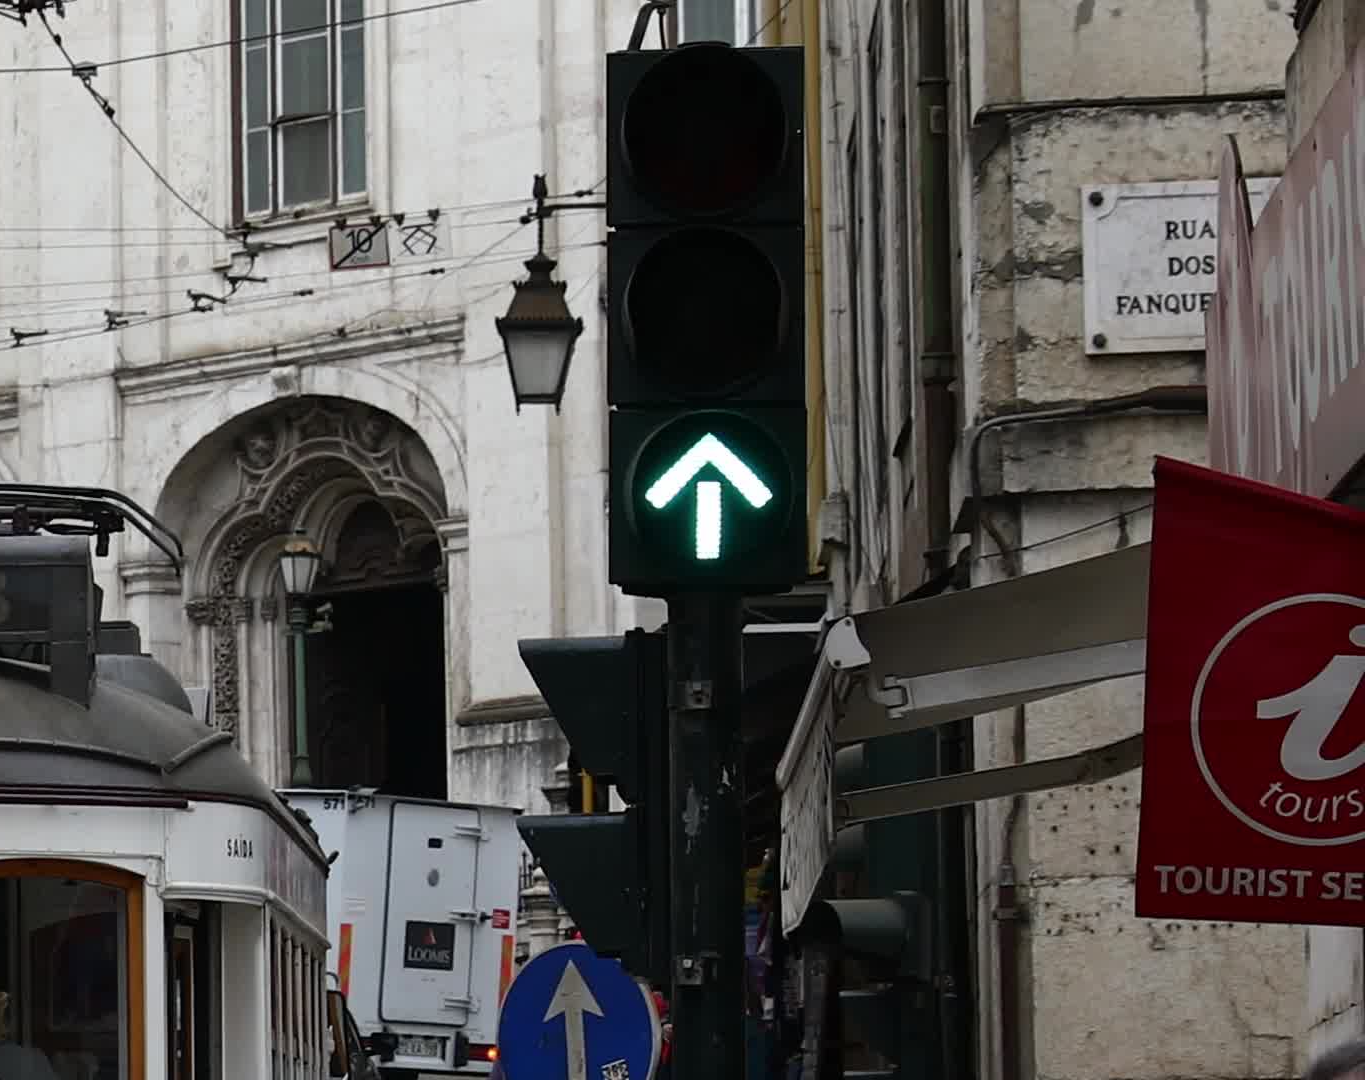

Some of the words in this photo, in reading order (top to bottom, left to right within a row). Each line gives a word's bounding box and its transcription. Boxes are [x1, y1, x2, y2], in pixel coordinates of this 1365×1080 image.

[1165, 220, 1215, 240] RUA
[1168, 255, 1215, 276] DOS
[1257, 780, 1365, 824] tours
[1153, 864, 1314, 900] TOURIST
